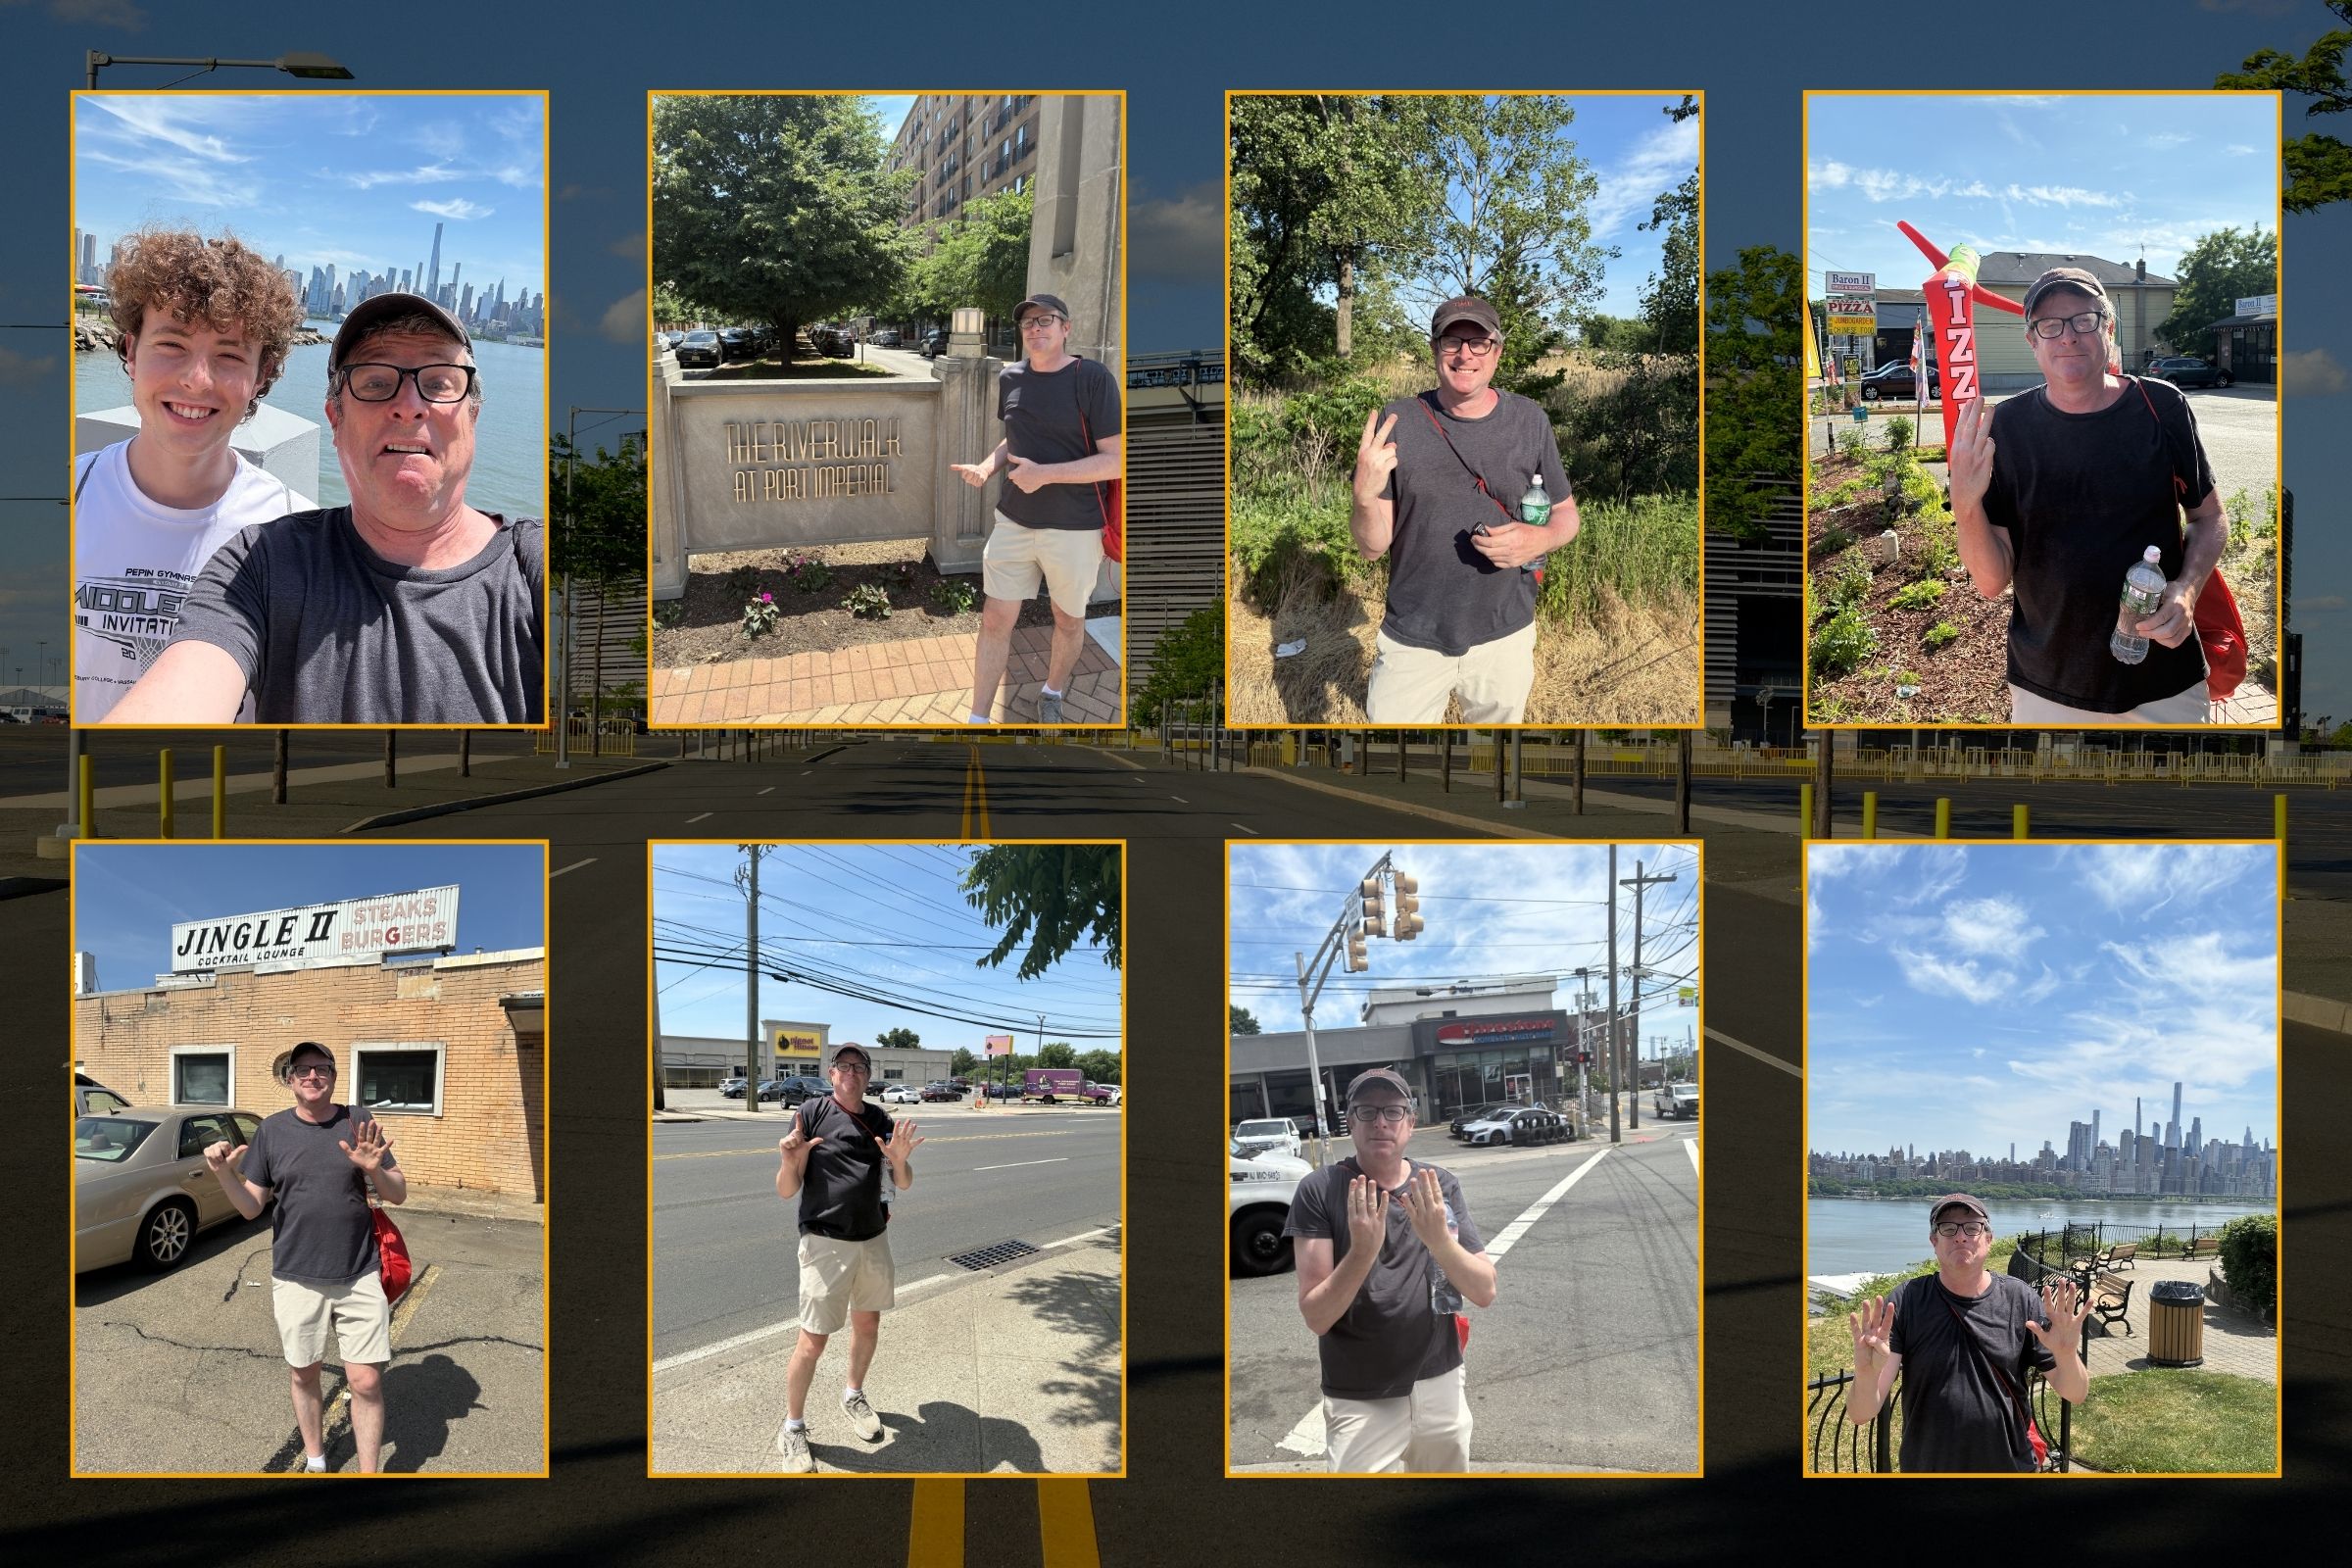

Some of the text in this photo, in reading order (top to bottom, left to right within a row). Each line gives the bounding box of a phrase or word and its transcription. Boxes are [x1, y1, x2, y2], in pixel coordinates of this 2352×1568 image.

[1833, 274, 1870, 284] Baron II
[1828, 303, 1874, 314] PIZZA
[723, 418, 904, 464] THE RIVERWALK
[733, 464, 895, 503] AT PORT IMPERIAL
[125, 567, 154, 577] PEPIN
[74, 582, 183, 619] IDDLE
[121, 647, 136, 661] 20
[353, 897, 438, 925] STEAKS
[177, 909, 339, 956] JINGLE II
[341, 921, 447, 950] BURGERS
[198, 946, 306, 967] COCKTAIL LOUNGE
